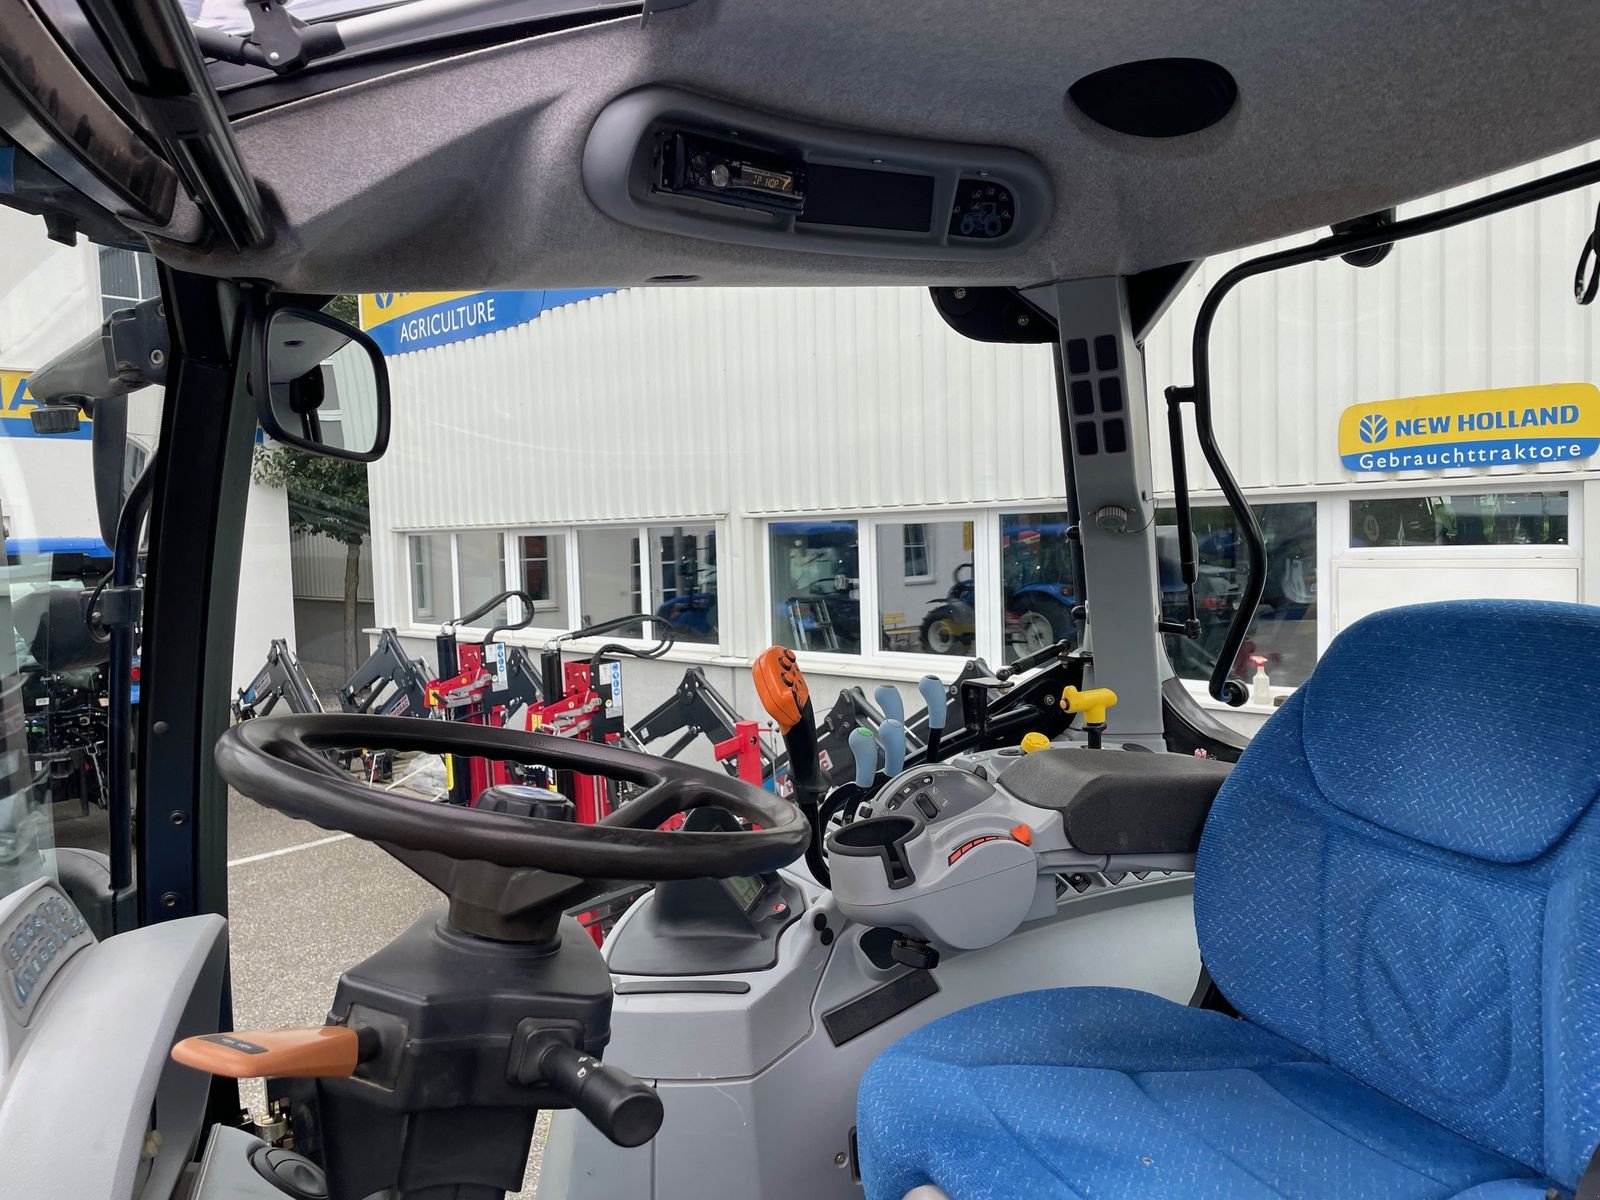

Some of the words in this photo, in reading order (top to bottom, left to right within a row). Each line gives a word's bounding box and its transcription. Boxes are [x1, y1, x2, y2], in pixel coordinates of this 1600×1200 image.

[400, 298, 496, 344] AGRICULTURE
[1395, 415, 1451, 437] NEW
[1457, 404, 1580, 432] HOLLAND
[1359, 443, 1582, 470] Gebrauchttraktore
